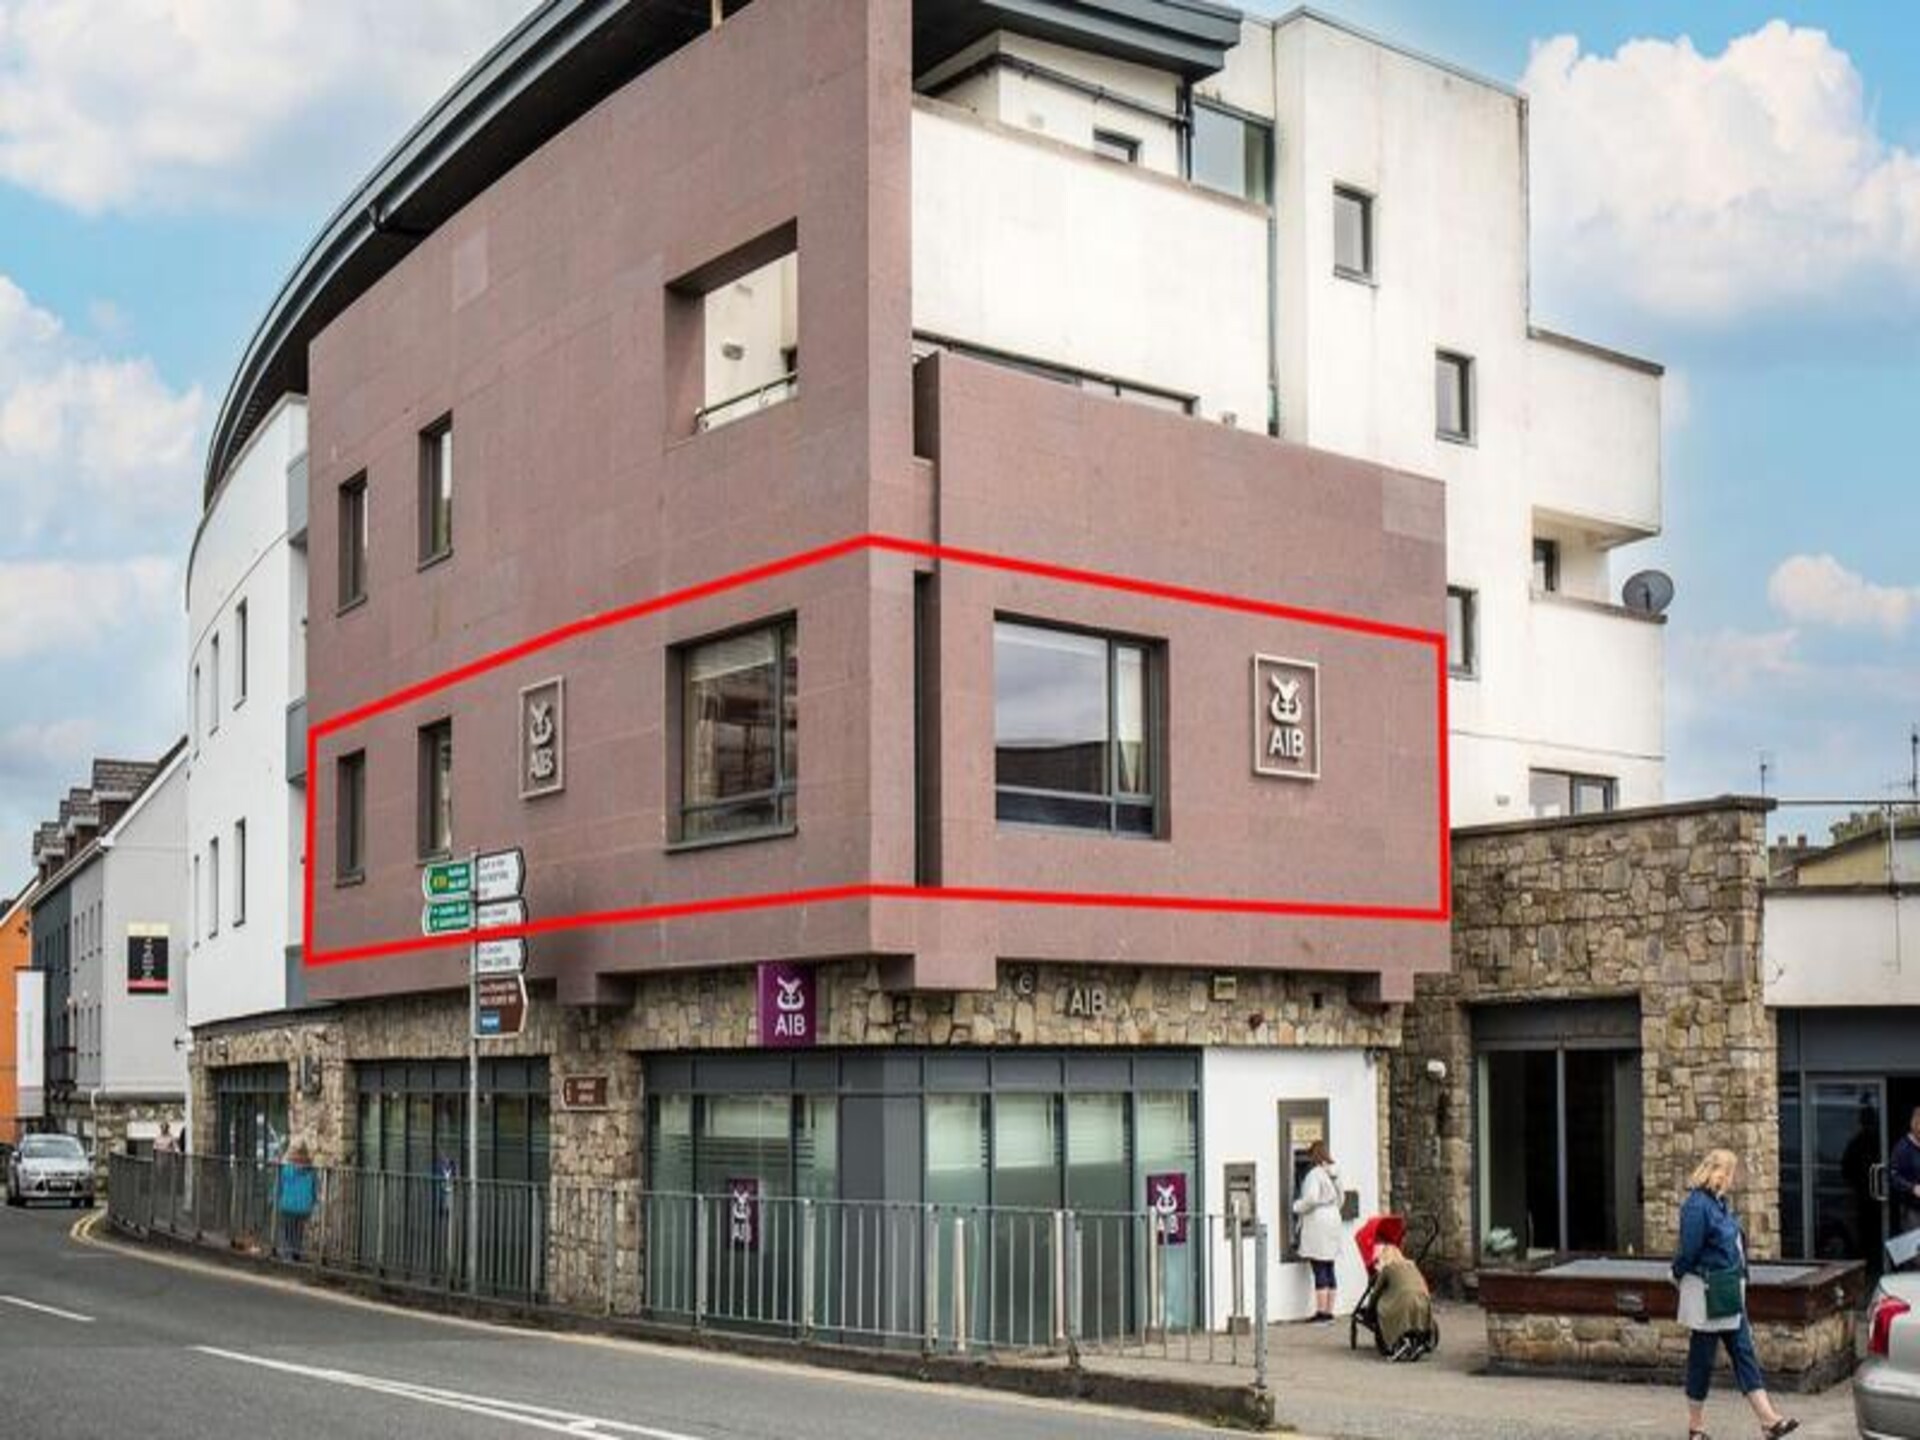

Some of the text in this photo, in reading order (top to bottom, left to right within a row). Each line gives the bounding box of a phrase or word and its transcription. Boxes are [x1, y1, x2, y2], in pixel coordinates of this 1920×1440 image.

[1269, 726, 1305, 757] AIB
[528, 748, 553, 778] AIB
[1070, 988, 1107, 1016] AIB
[775, 1013, 806, 1037] AIB
[1156, 1214, 1179, 1233] AB
